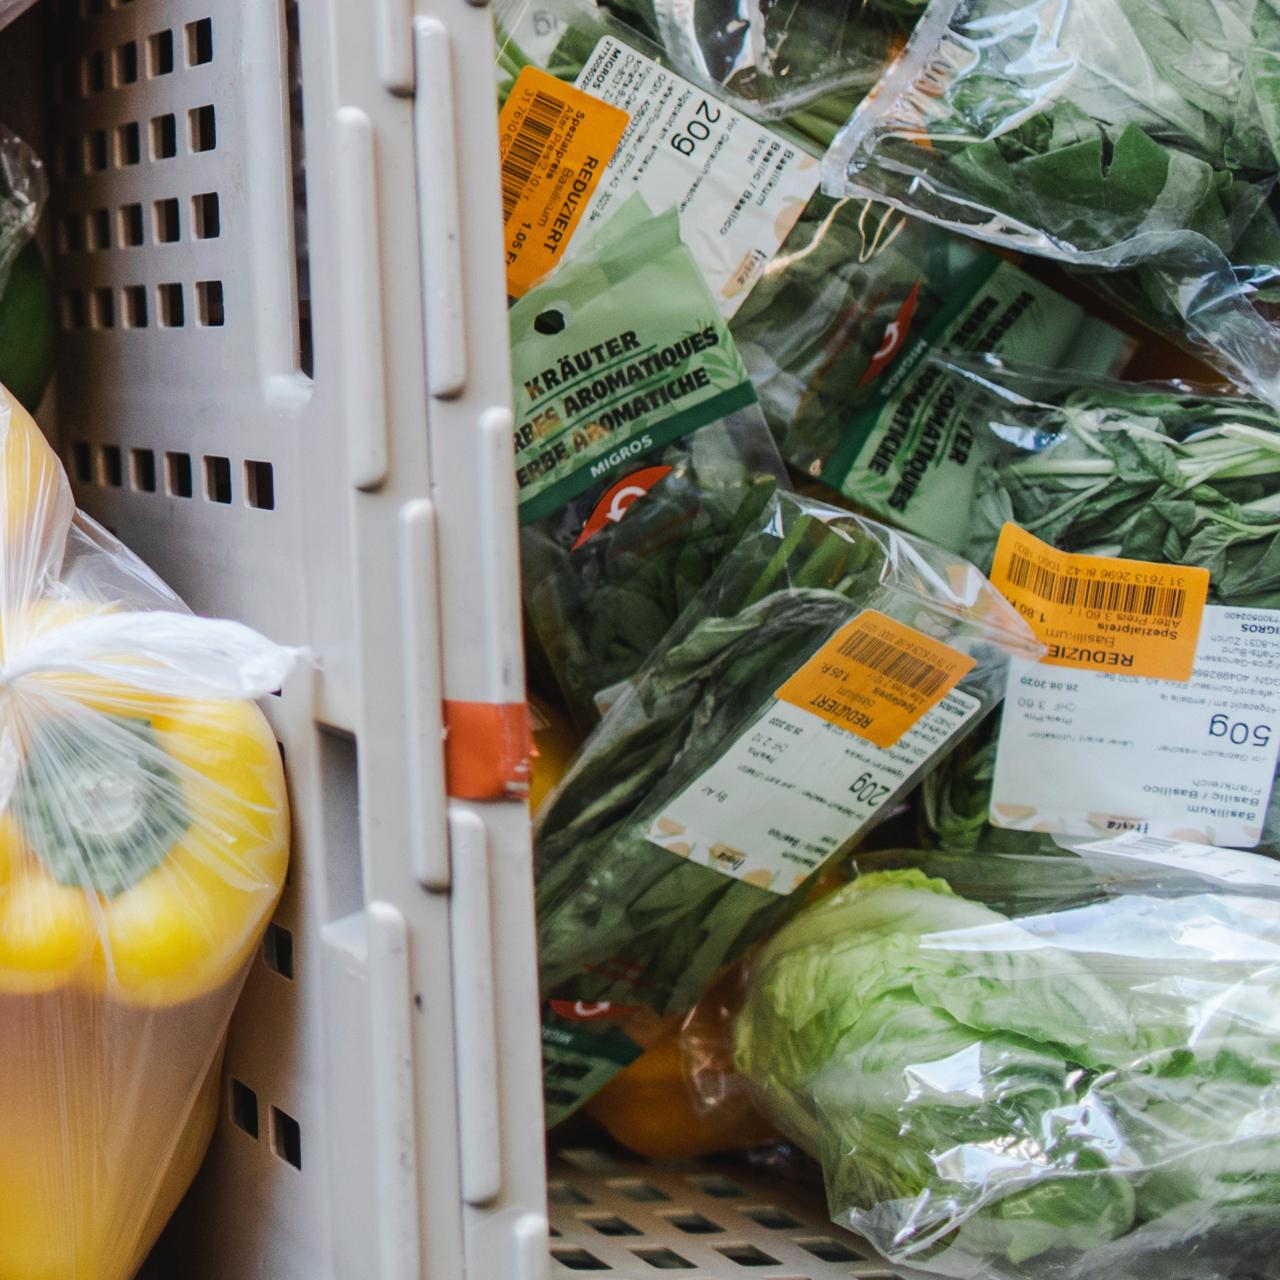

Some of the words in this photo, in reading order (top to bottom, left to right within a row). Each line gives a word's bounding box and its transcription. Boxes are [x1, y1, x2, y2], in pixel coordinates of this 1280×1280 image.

[591, 46, 621, 90] MIGROS
[520, 87, 534, 103] 31
[505, 104, 526, 133] 7610
[558, 104, 575, 127] Alter
[668, 95, 723, 161] 20g
[540, 132, 561, 161] Preis
[543, 109, 585, 180] Spezialpreis
[751, 140, 781, 182] Basilic
[754, 148, 794, 208] Basilikum
[536, 166, 574, 228] Basilikum
[542, 155, 599, 254] REDUZIERT
[718, 188, 753, 238] Basilico
[510, 220, 531, 251] 1.05
[523, 328, 641, 401] KRÄUTER
[560, 325, 720, 418] AROMATIQUES
[878, 337, 928, 396] MIGROS
[516, 438, 571, 491] ERBE
[569, 365, 711, 453] AROMATICHE
[589, 434, 653, 478] MIGROS
[886, 384, 963, 513] OMATIQUES
[1134, 571, 1164, 584] 7613
[1169, 576, 1183, 587] 31
[1018, 602, 1045, 622] 1.80
[1116, 613, 1146, 625] Preis
[1151, 617, 1180, 629] Alter
[1044, 627, 1115, 647] Basilikum
[1096, 619, 1178, 640] Spezialpreis
[1240, 623, 1278, 634] IGROS
[1047, 644, 1133, 667] REDUZIE
[829, 667, 850, 681] 1.05
[809, 693, 874, 728] REDUZIERT
[1207, 712, 1272, 747] 50g
[845, 771, 893, 808] 20g
[1141, 784, 1198, 798] Basilico
[1192, 778, 1261, 794] Frankreich
[1204, 791, 1259, 806] Basilic
[1186, 804, 1255, 821] Basilikum
